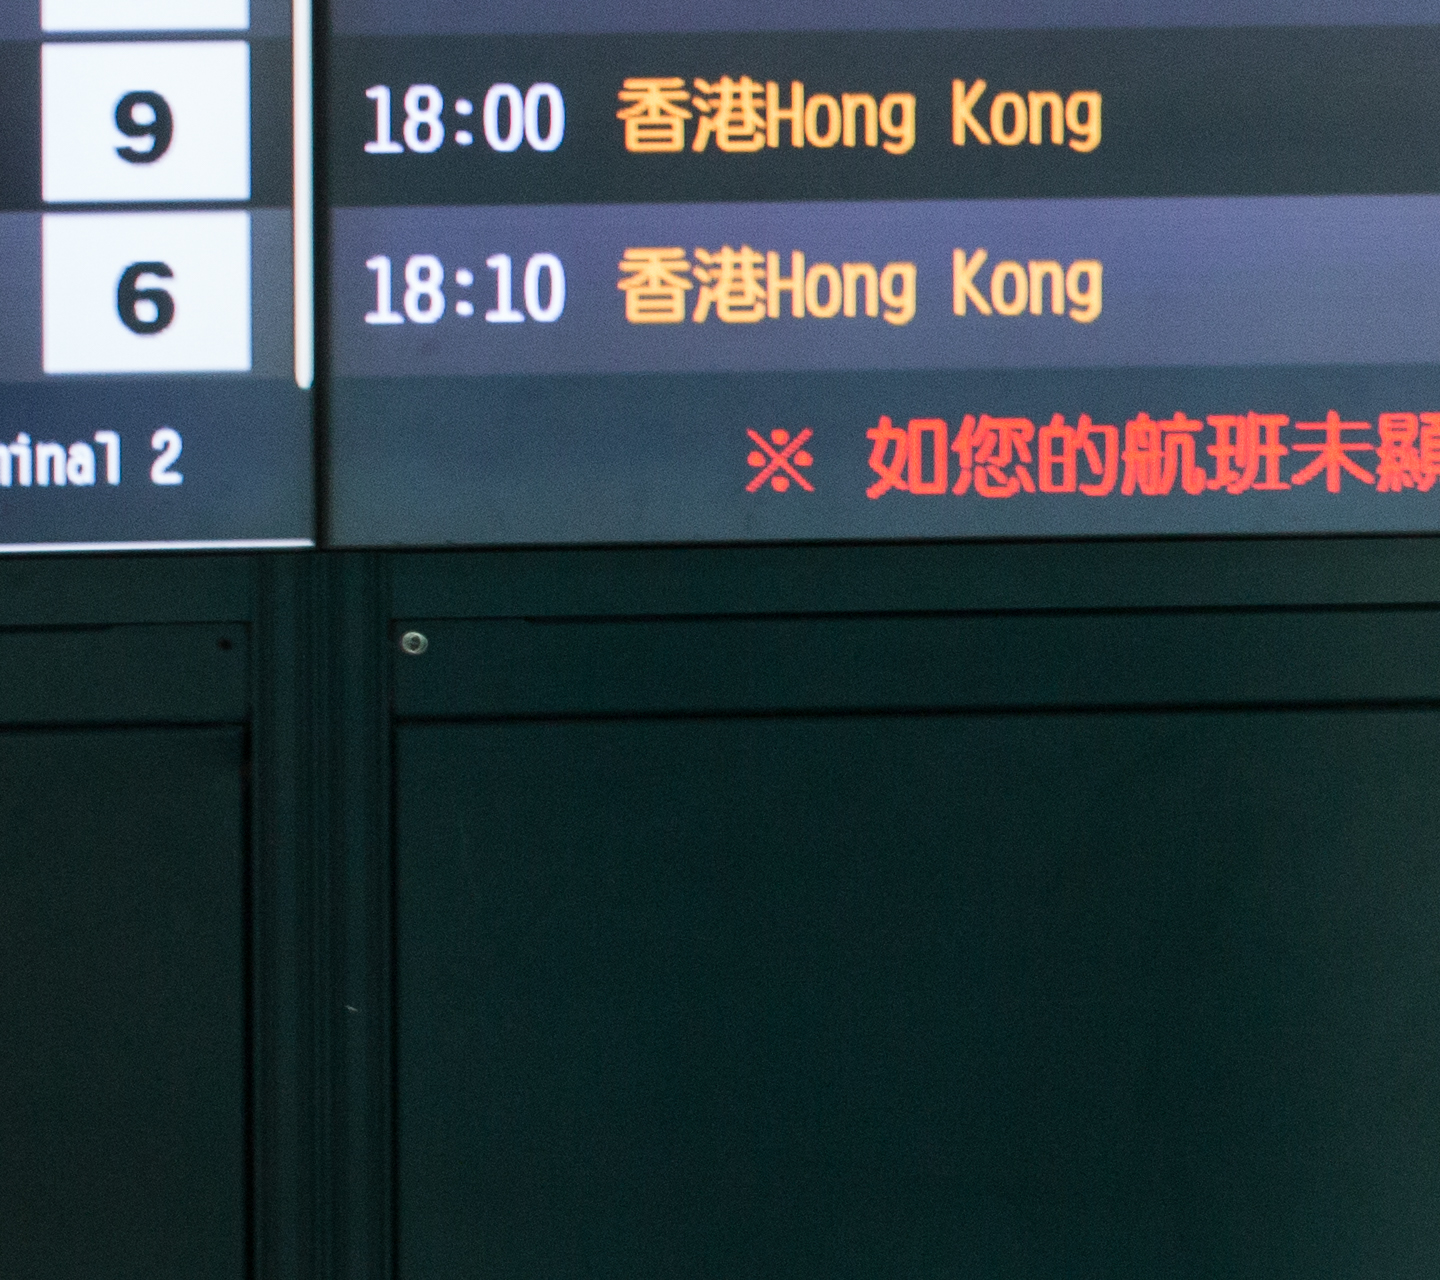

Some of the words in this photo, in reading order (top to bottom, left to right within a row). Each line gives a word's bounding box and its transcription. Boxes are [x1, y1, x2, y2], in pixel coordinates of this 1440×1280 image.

[113, 90, 174, 165] 9
[364, 83, 565, 154] 18:00
[950, 77, 1103, 154] Kong
[115, 260, 176, 336] 6
[364, 252, 566, 325] 18:10
[951, 248, 1103, 324] Kong
[149, 427, 184, 486] 2
